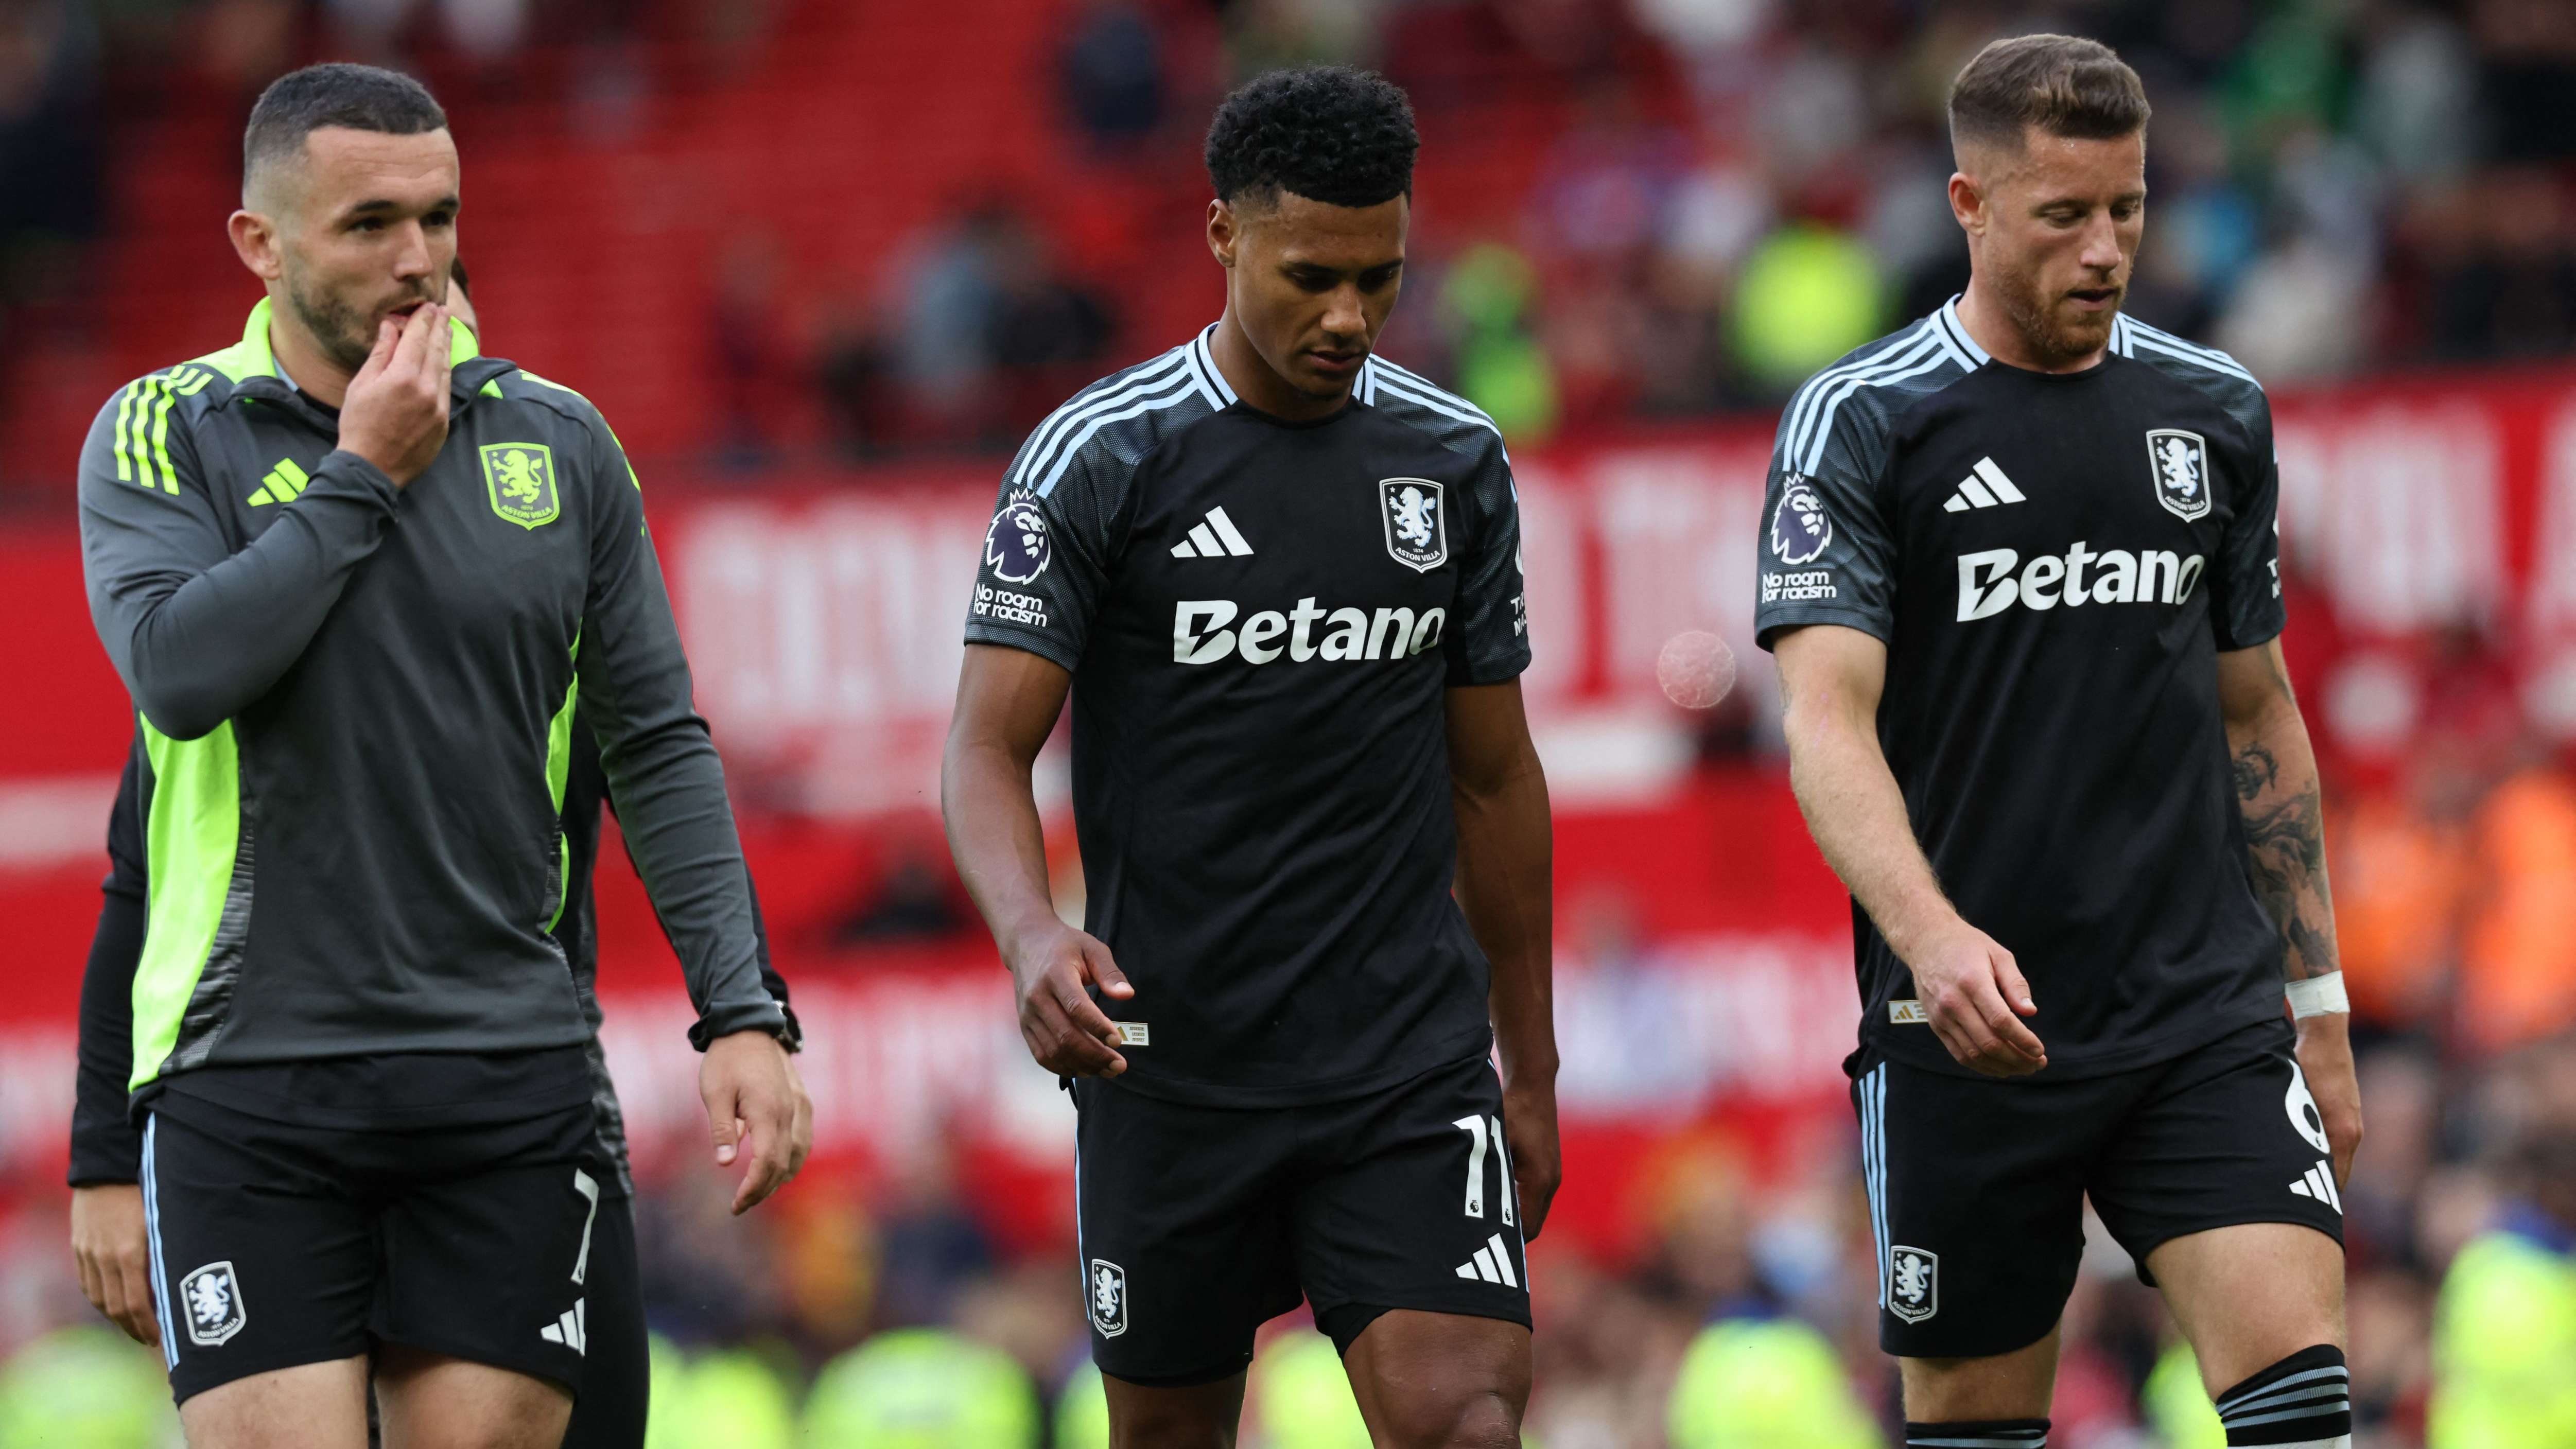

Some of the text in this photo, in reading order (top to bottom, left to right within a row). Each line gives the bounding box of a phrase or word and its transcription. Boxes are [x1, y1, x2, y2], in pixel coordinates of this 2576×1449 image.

[1395, 547, 1440, 561] ASTON VILLA
[1763, 571, 1829, 588] No room
[1957, 540, 2205, 622] Betano
[976, 583, 1042, 611] No room
[1762, 585, 1837, 603] for racism
[973, 599, 1047, 627] for racism
[1174, 597, 1446, 664] Betano
[2285, 1058, 2330, 1154] 6
[1108, 1322, 1121, 1330] VILLA
